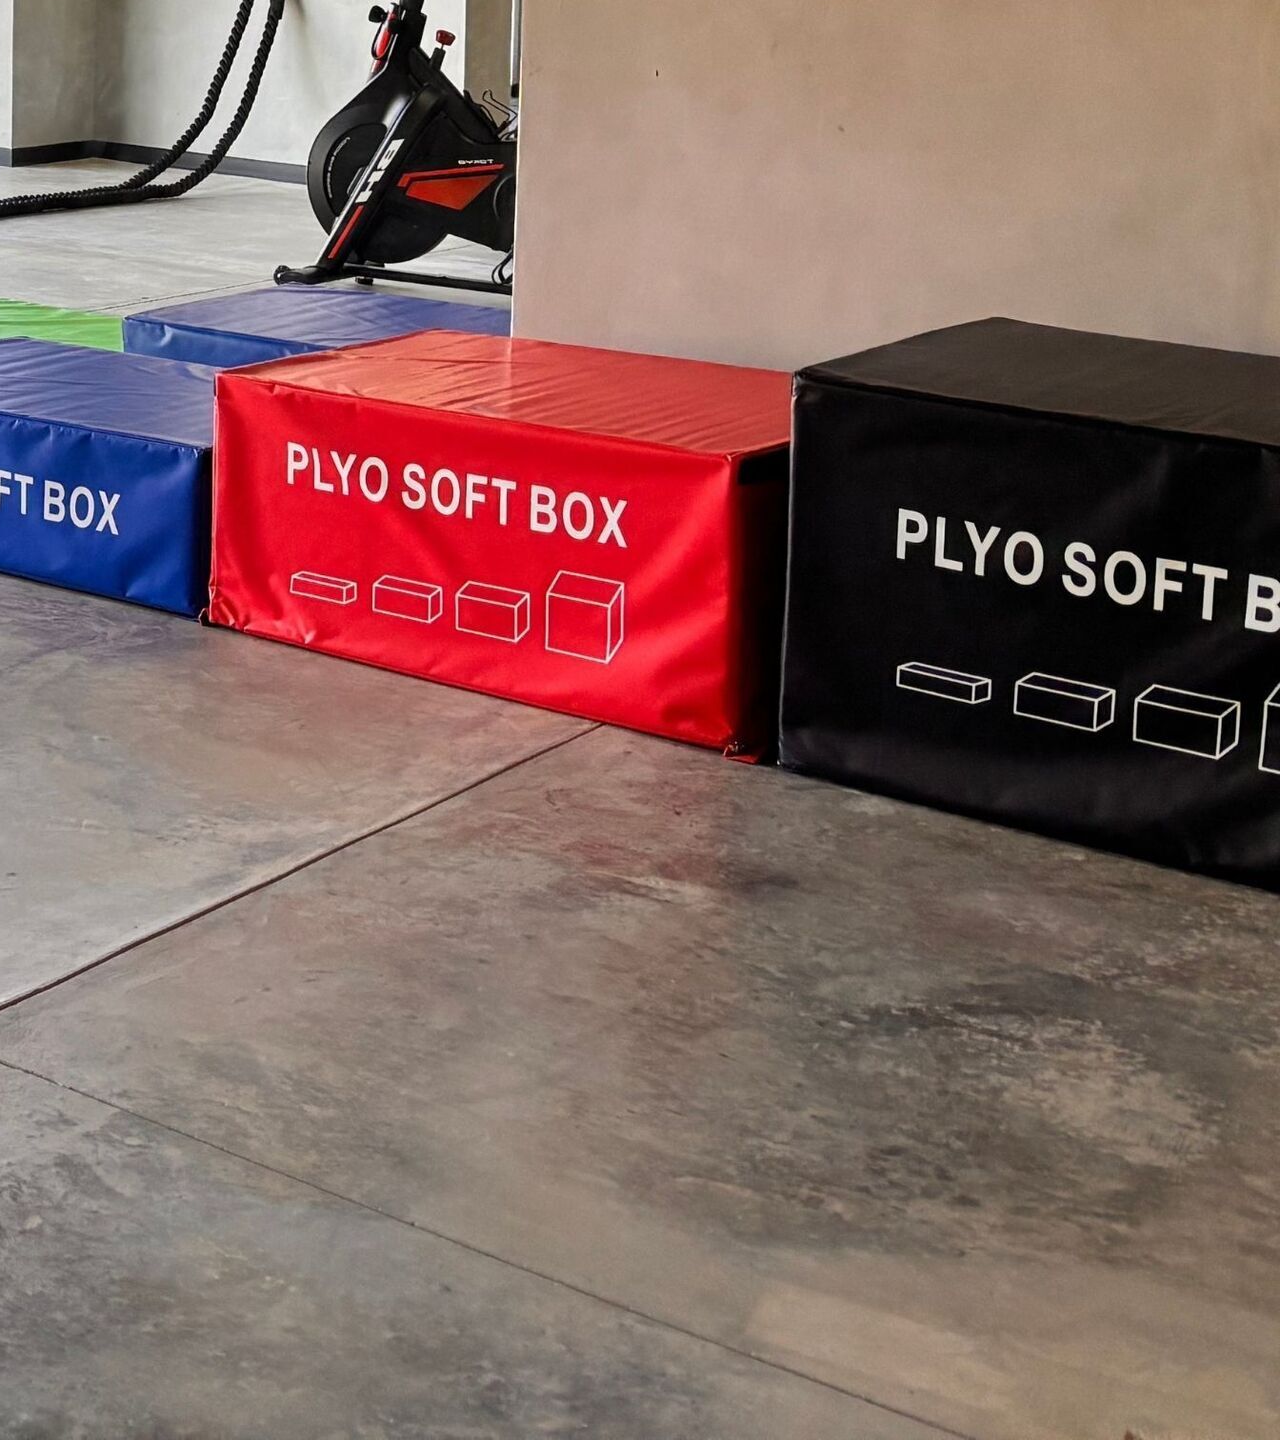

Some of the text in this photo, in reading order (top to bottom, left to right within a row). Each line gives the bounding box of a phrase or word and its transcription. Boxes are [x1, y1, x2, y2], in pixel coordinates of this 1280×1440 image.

[43, 480, 121, 535] BOX
[287, 441, 627, 548] PLYO SOFT BOX
[896, 508, 1044, 586] PLYO
[1061, 541, 1228, 621] SOFT
